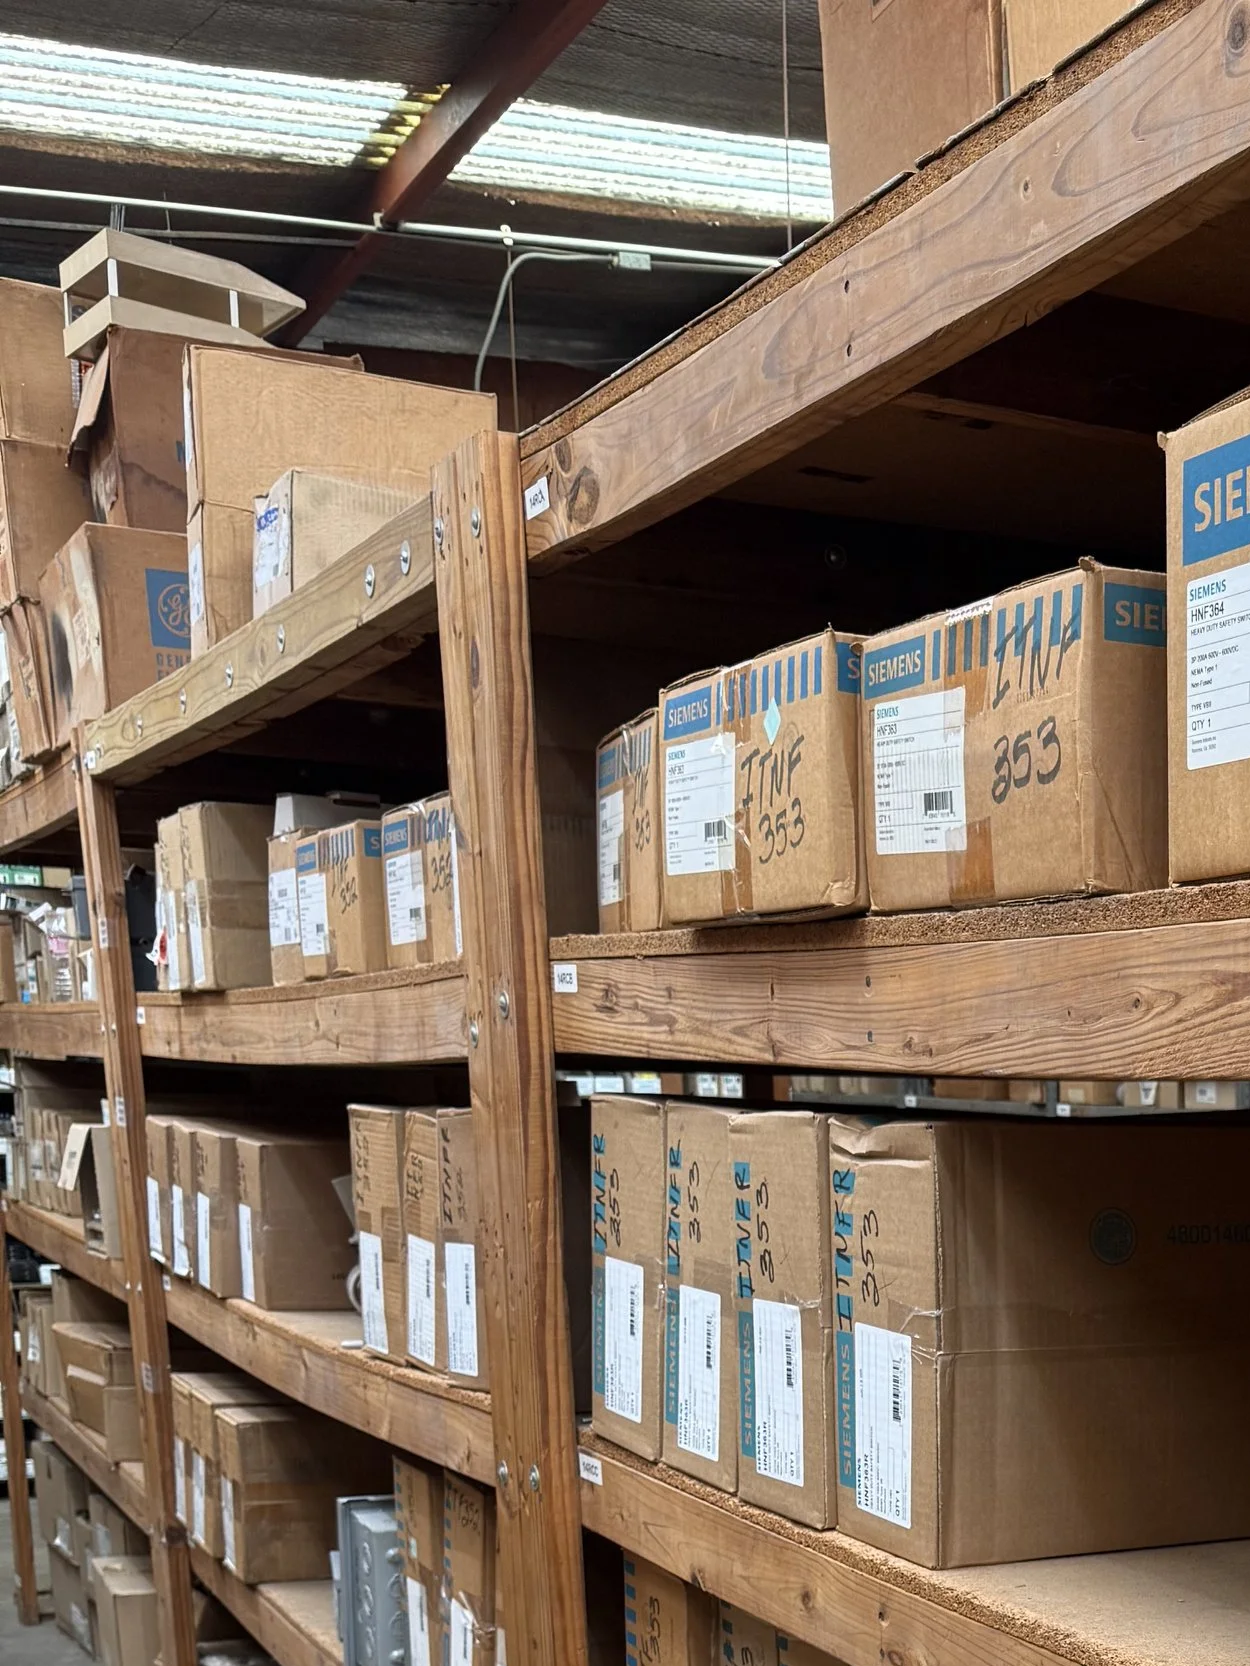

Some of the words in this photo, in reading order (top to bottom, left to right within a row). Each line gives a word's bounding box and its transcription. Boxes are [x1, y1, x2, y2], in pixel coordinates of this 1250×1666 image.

[1189, 579, 1227, 602] SIEMENS
[1190, 601, 1225, 623] HNF364
[868, 650, 921, 687] SIEMENS
[668, 698, 708, 728] SIEMENS
[876, 706, 899, 720] SIEMENS
[1191, 719, 1206, 732] QTY
[1207, 718, 1212, 729] 1
[741, 734, 805, 815] ITNF
[992, 715, 1062, 804] 353
[758, 797, 805, 865] 353
[609, 1167, 622, 1248] 353
[689, 1161, 700, 1245] 353
[735, 1167, 756, 1300] ITNFR
[756, 1179, 774, 1284] 353
[833, 1167, 853, 1331] ITNFR
[862, 1208, 880, 1308] 353
[741, 1322, 752, 1447] SIEMENS
[840, 1342, 852, 1479] SIEMENS
[893, 1497, 901, 1518] QTY
